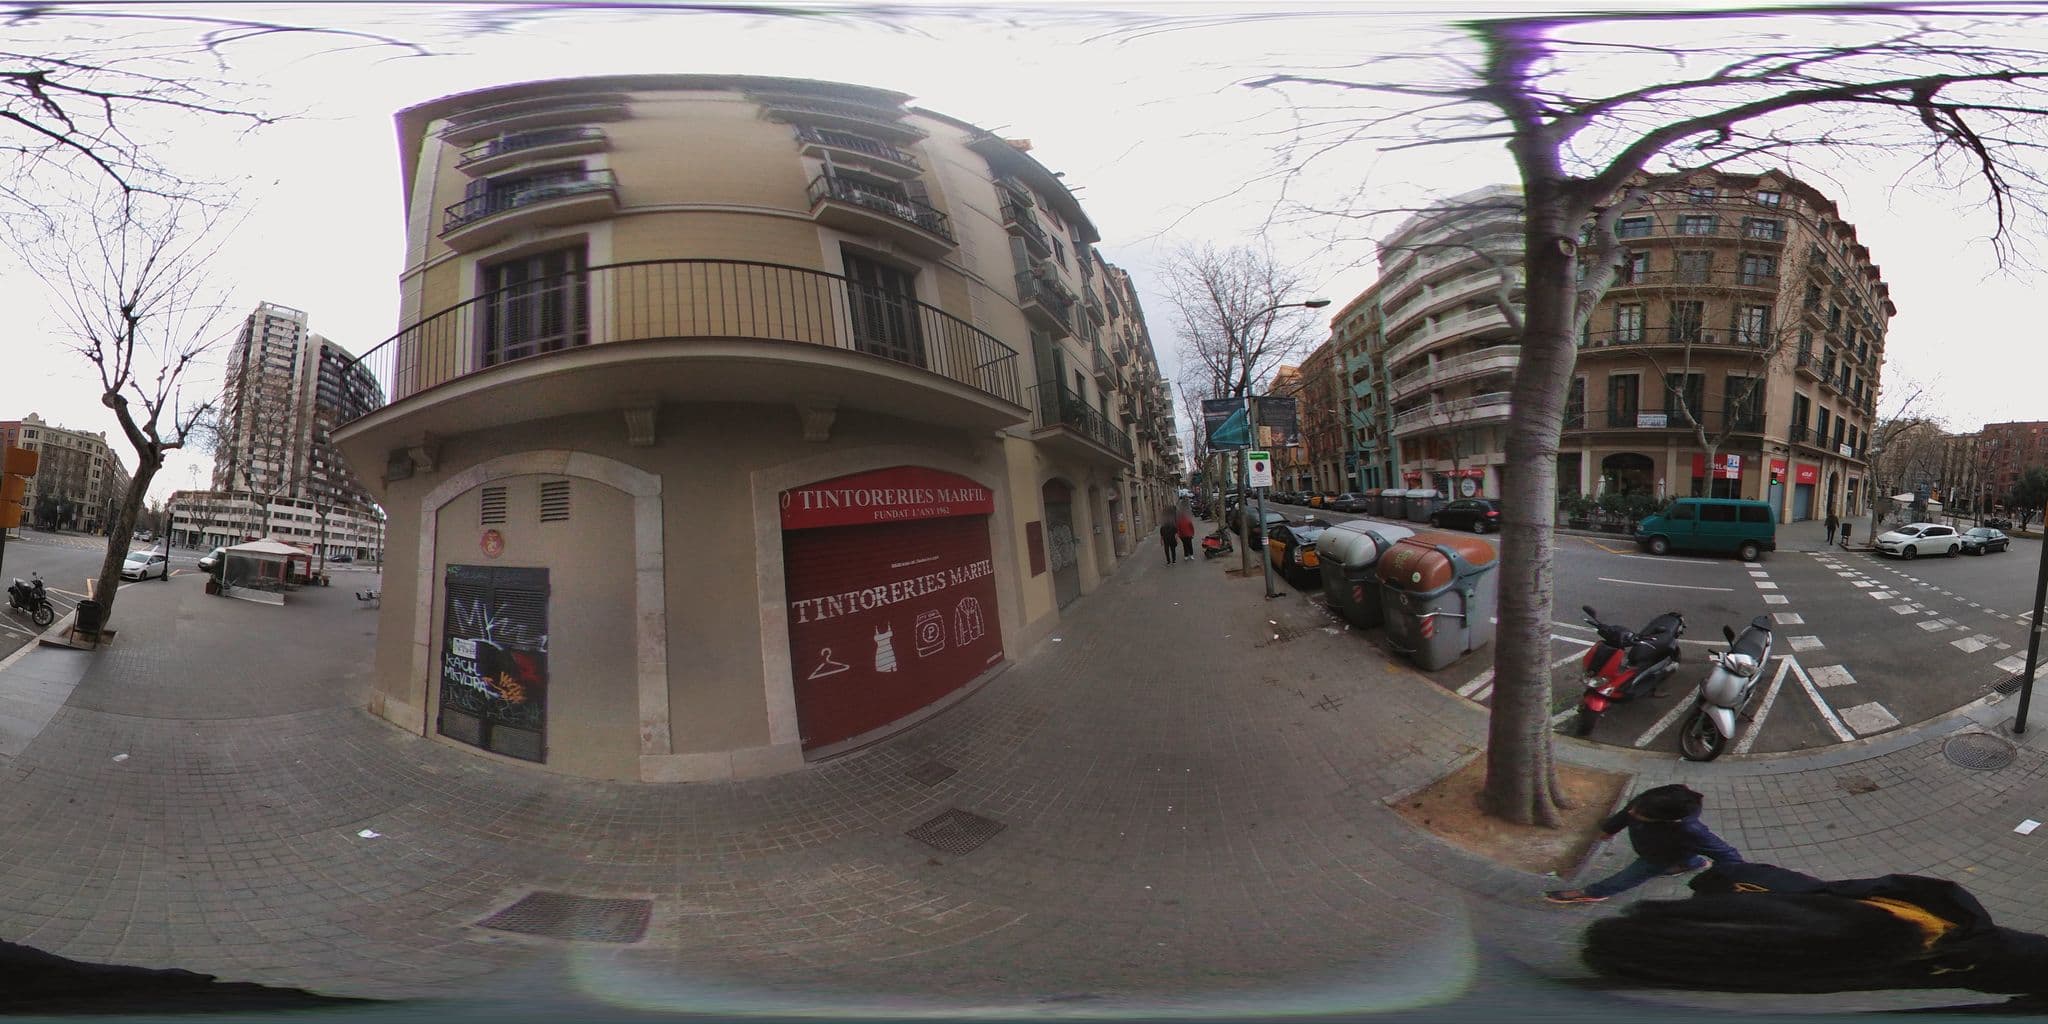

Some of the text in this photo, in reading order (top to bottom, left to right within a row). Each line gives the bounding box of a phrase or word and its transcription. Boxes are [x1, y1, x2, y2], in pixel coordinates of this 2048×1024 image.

[799, 488, 986, 510] TINTORERIES MARFIL
[874, 509, 909, 520] FUNDAT
[792, 559, 994, 624] TINTORERIES MARFIL
